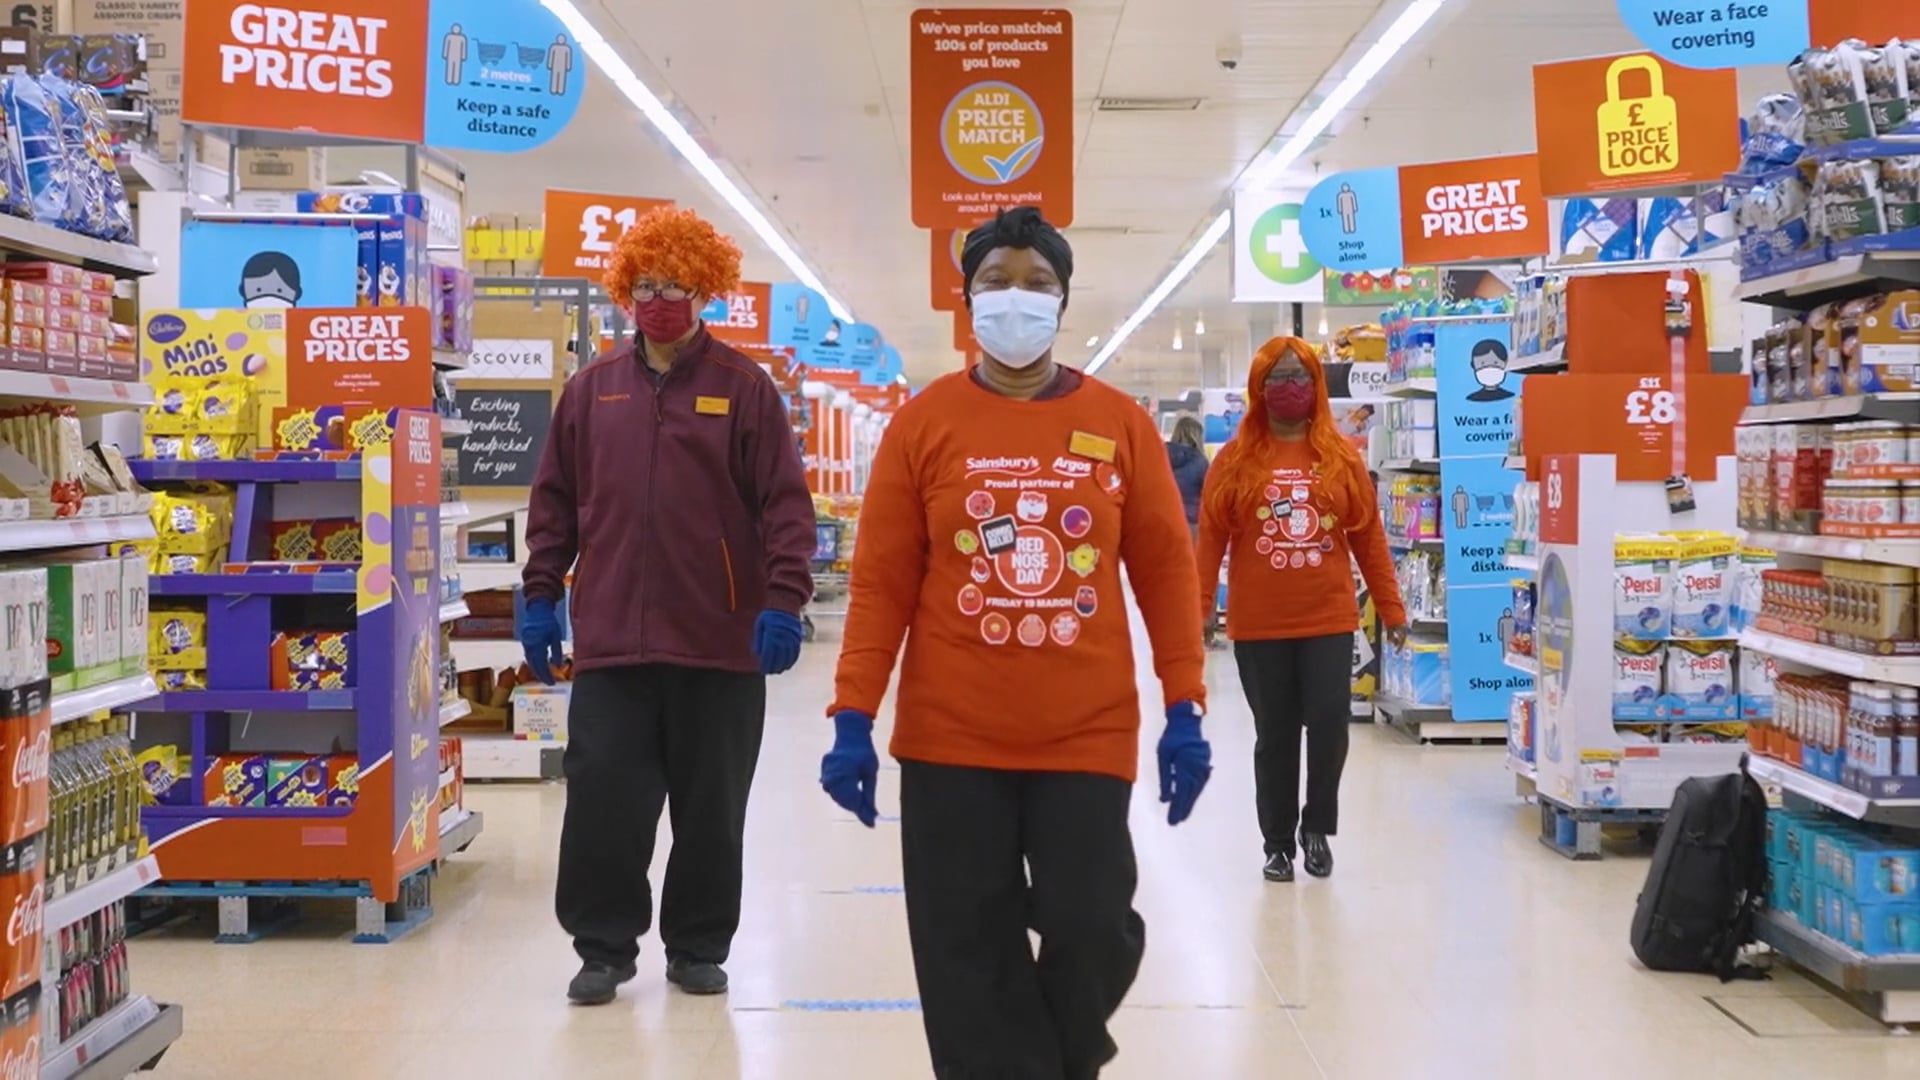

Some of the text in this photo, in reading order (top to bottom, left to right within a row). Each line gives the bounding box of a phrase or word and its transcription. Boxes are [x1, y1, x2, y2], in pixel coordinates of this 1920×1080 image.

[94, 12, 182, 20] ASSORTED CRISPS
[1653, 2, 1768, 27] Wear a face
[230, 4, 388, 55] GREAT
[920, 22, 1062, 37] We've price matched
[934, 39, 1048, 54] 100s of products
[1671, 28, 1755, 50] covering
[219, 44, 393, 98] PRICES
[962, 56, 1020, 72] you love
[480, 67, 532, 82] 2 metres
[974, 93, 1010, 106] ALDI
[457, 98, 550, 119] Keep a safe
[1627, 103, 1646, 127] £
[957, 109, 1026, 127] PRICE
[467, 118, 537, 137] distance
[958, 128, 1026, 145] MATCH
[1606, 126, 1670, 148] PRICE
[1608, 144, 1672, 170] LOCK
[942, 192, 1042, 203] Look out for the symbol
[1425, 179, 1521, 212] GREAT
[957, 204, 989, 213] around
[1320, 207, 1333, 219] 1x
[1421, 205, 1529, 239] PRICES
[1338, 239, 1365, 251] Shop
[1338, 250, 1367, 262] alone
[309, 315, 404, 339] GREAT
[163, 332, 218, 369] Mini
[303, 339, 411, 363] PRICES
[472, 352, 543, 365] SCOVER
[470, 396, 521, 418] Exciting
[1625, 390, 1677, 425] £8
[409, 415, 430, 440] GREAT
[1454, 415, 1488, 427] Wear
[1492, 415, 1500, 426] a
[408, 440, 432, 465] PRICES
[461, 436, 533, 457] handpicked
[473, 456, 517, 480] for you
[965, 456, 1092, 472] Sainsbury's Argos
[984, 479, 1075, 490] Proud partner of
[1016, 537, 1044, 552] RED
[1461, 545, 1494, 559] Keep
[1011, 552, 1049, 569] NOSE
[1016, 569, 1045, 585] DAY
[1624, 576, 1662, 594] Persil
[1686, 573, 1722, 592] Persil
[986, 597, 1073, 608] FRIDAY 19 MARCH
[1479, 632, 1493, 643] 1x
[1621, 656, 1659, 672] Persil
[1690, 656, 1726, 671] Persil
[1469, 675, 1535, 691] Shop alon
